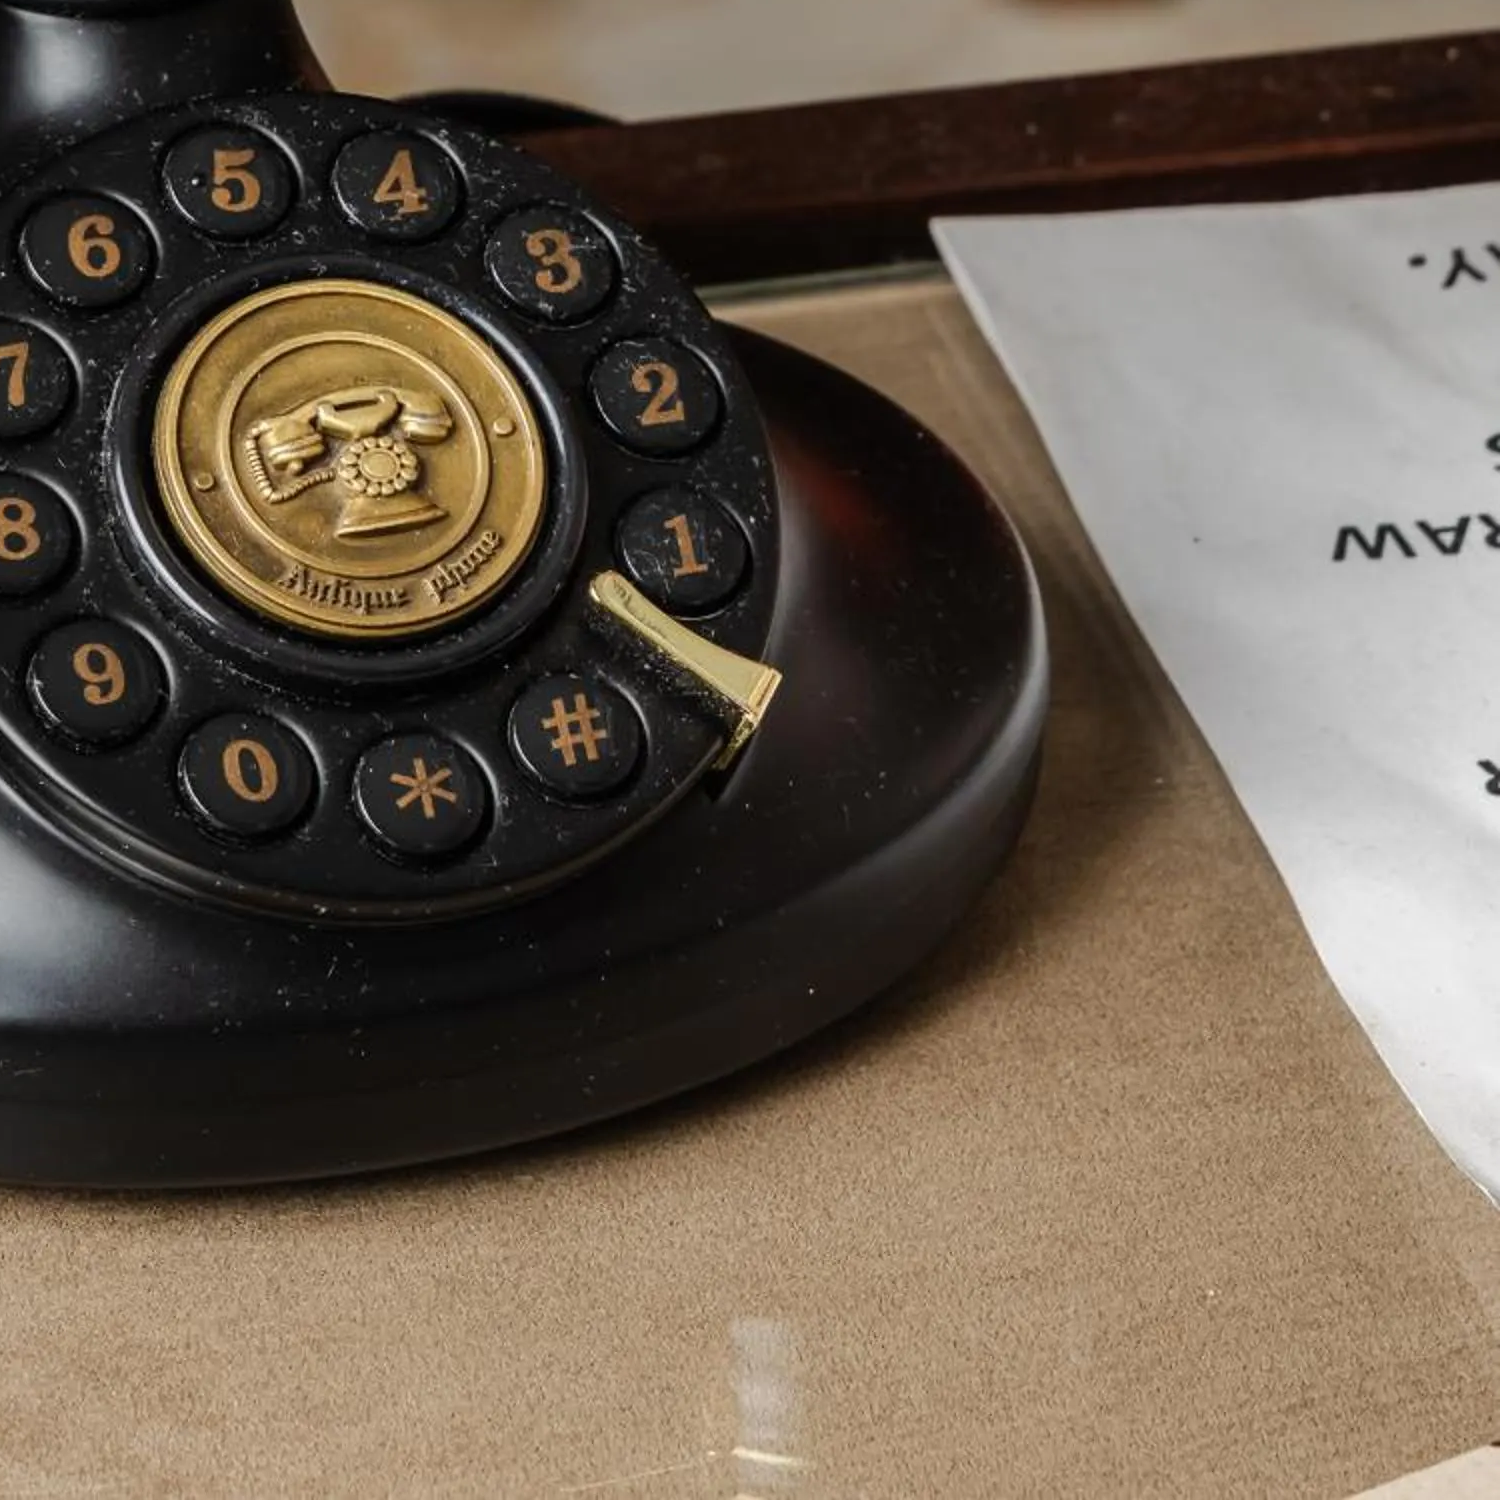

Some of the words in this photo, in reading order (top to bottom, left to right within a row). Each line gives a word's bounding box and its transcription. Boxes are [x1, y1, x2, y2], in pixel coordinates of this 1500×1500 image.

[210, 148, 262, 214] 5
[373, 148, 428, 219] 4
[66, 214, 122, 279] 6
[525, 228, 583, 294] 3
[631, 362, 686, 427] 2
[663, 514, 708, 578] 1
[73, 642, 127, 706] 9
[220, 738, 279, 804] 0
